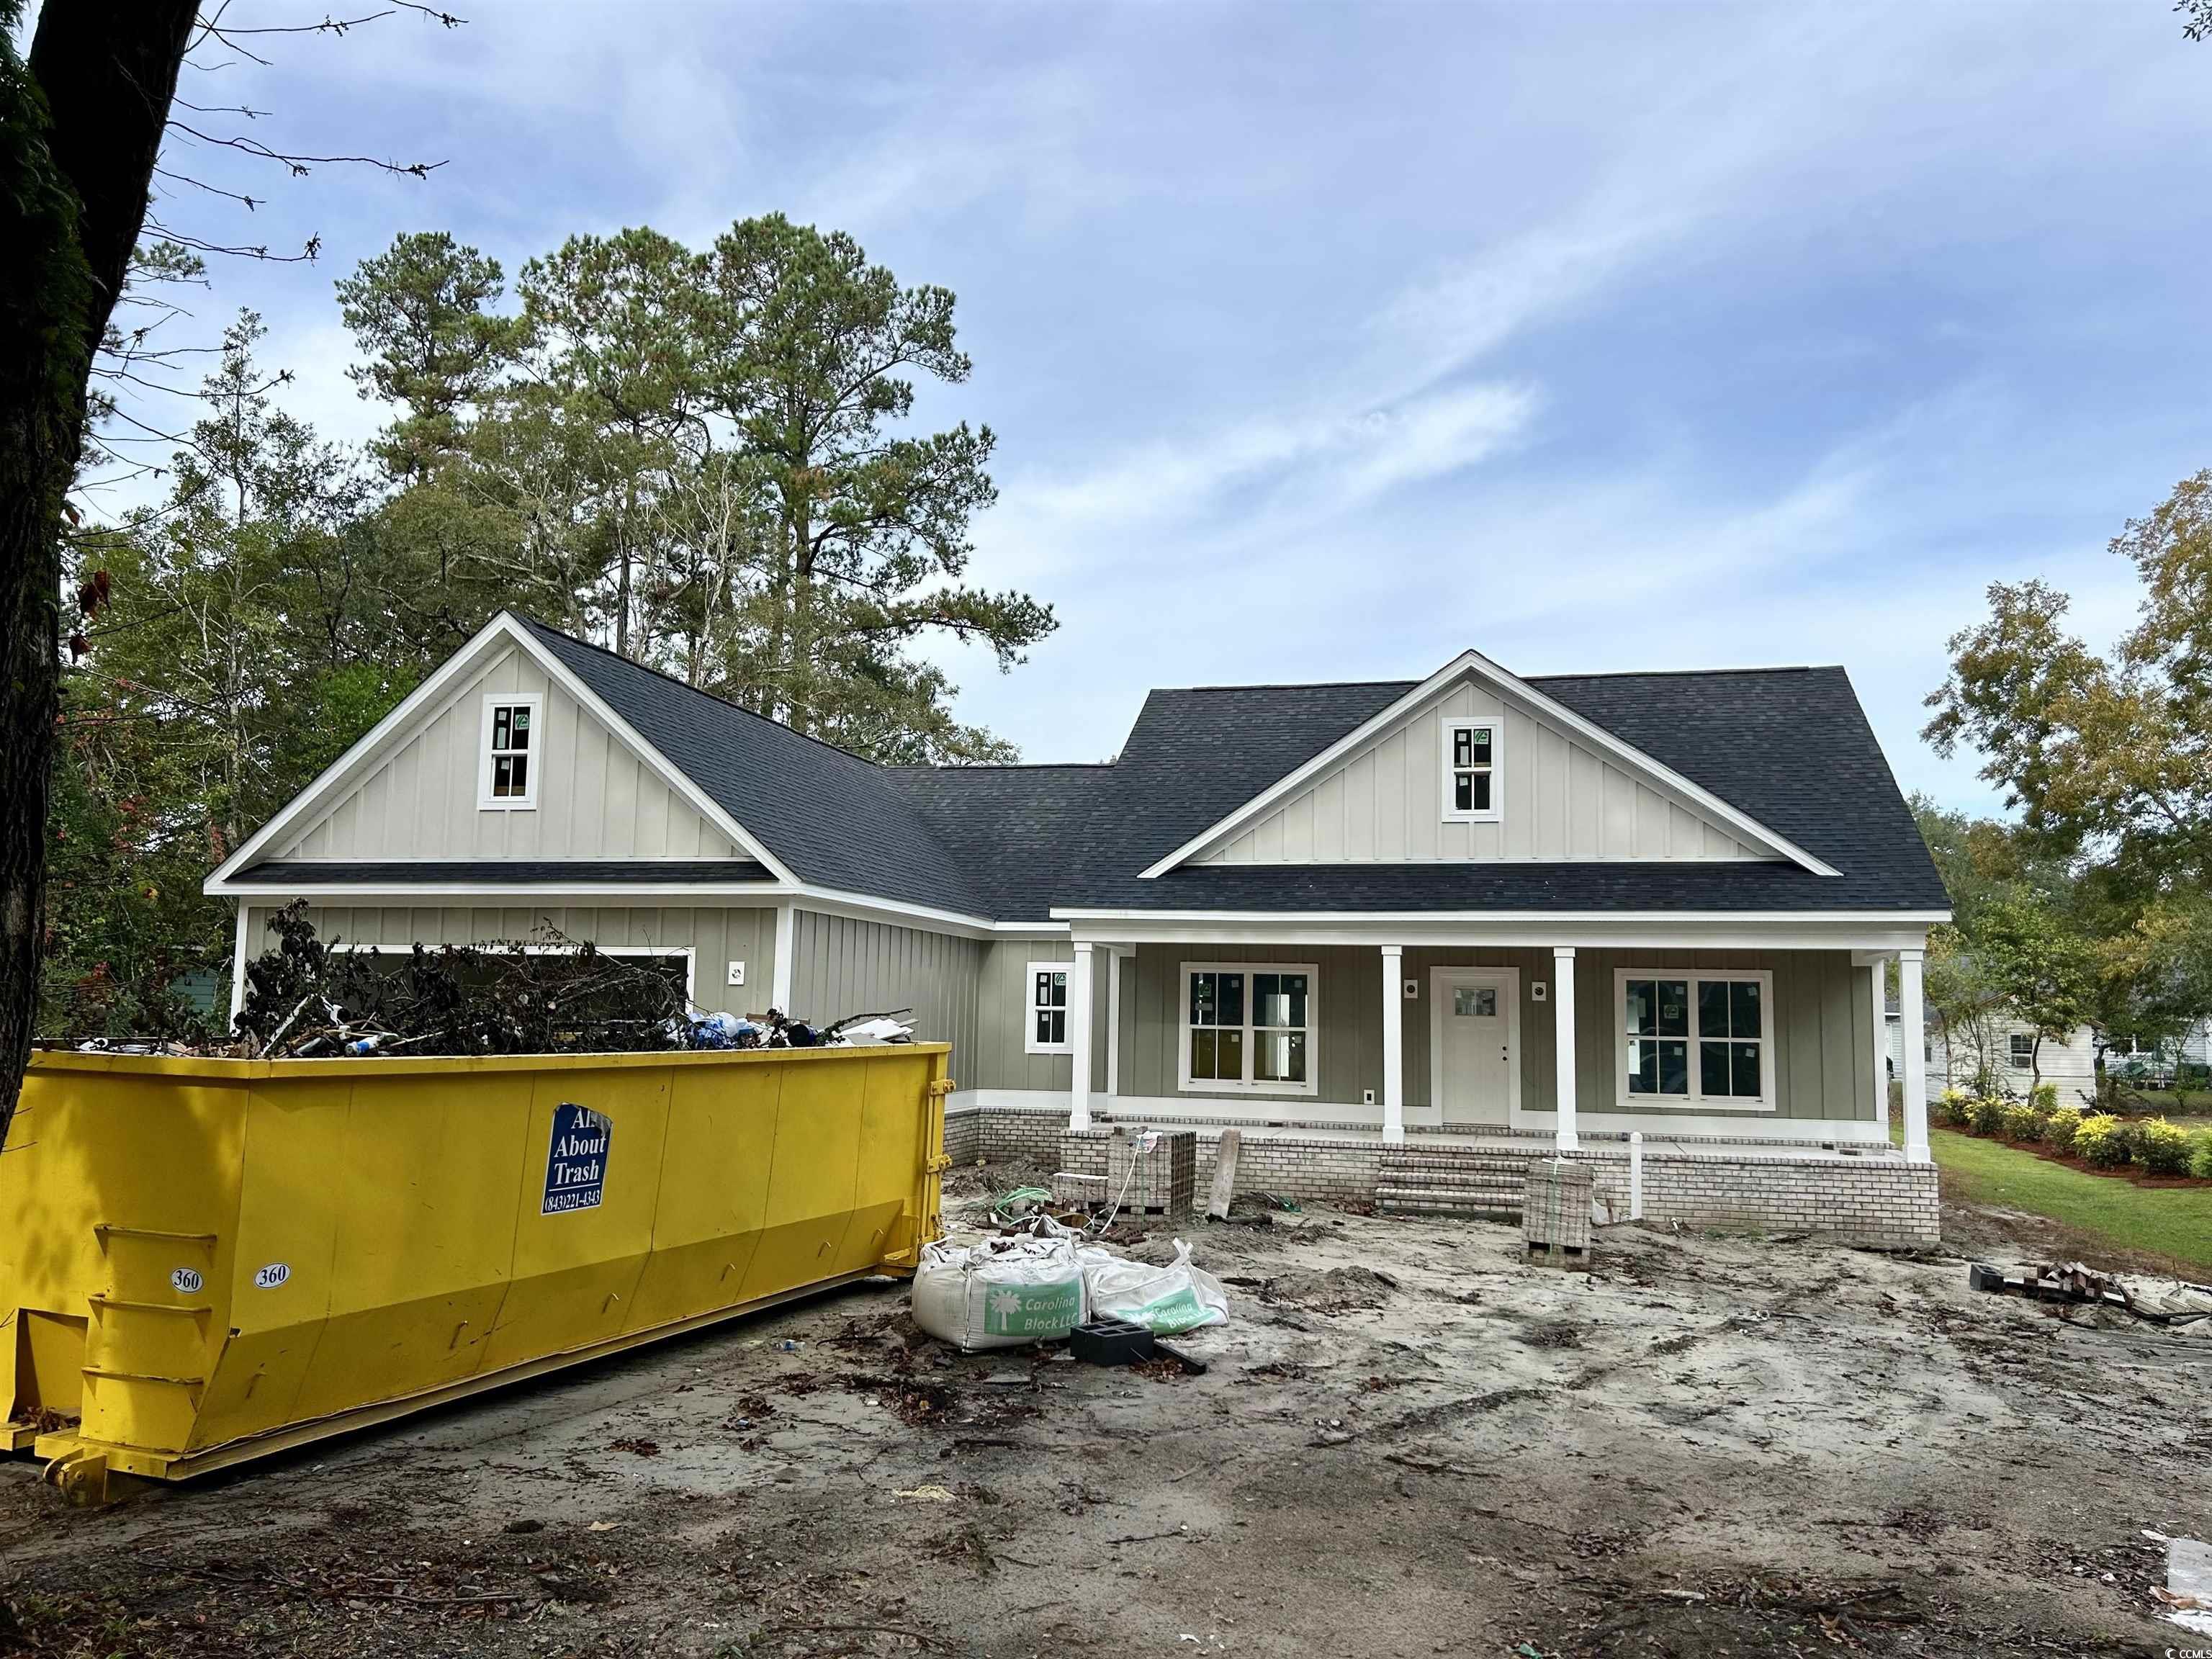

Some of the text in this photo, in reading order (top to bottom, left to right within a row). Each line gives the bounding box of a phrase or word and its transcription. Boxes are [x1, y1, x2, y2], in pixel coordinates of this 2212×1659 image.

[554, 1135, 606, 1158] About
[554, 1159, 599, 1185] Trash
[544, 1190, 601, 1212] (843)221-4343
[174, 1270, 199, 1290] 360
[258, 1265, 286, 1285] 360
[1025, 1296, 1075, 1310] Carolina
[1024, 1313, 1078, 1330] Block LLC
